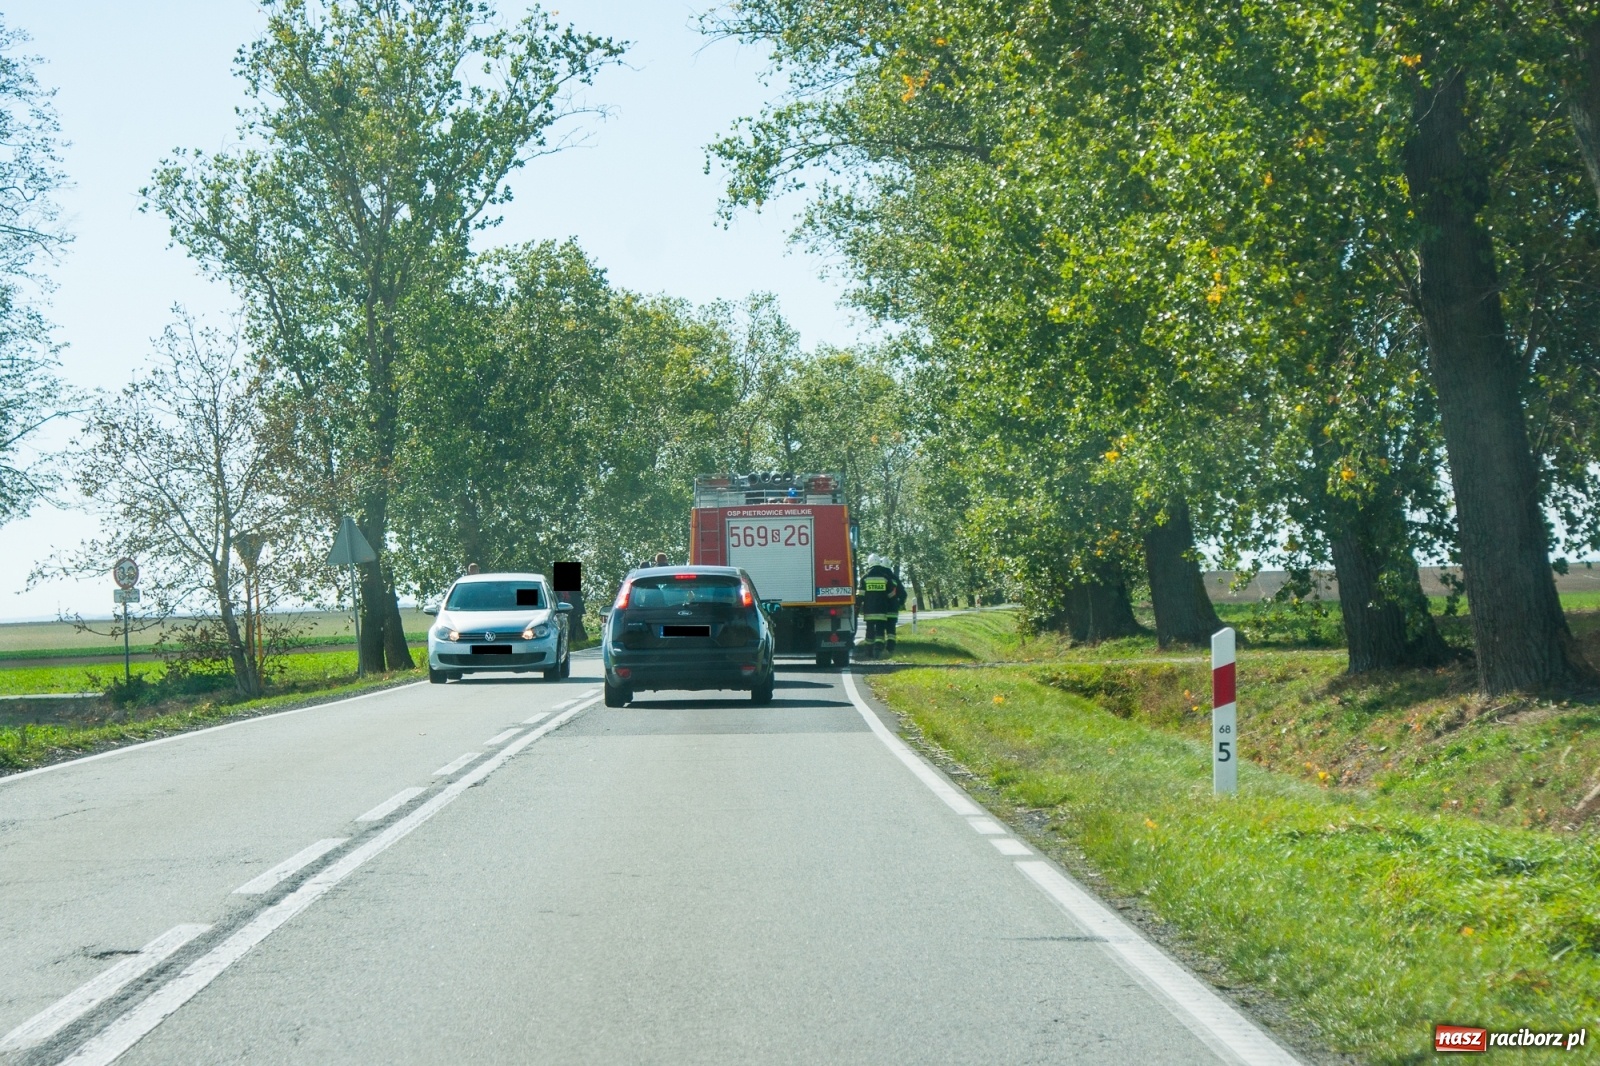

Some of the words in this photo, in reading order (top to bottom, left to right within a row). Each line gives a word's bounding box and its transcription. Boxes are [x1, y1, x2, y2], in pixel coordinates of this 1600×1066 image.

[742, 509, 783, 517] PIETROWICE
[730, 526, 768, 548] 569
[784, 524, 810, 547] 26
[1218, 724, 1231, 734] 68
[1218, 741, 1231, 762] 5
